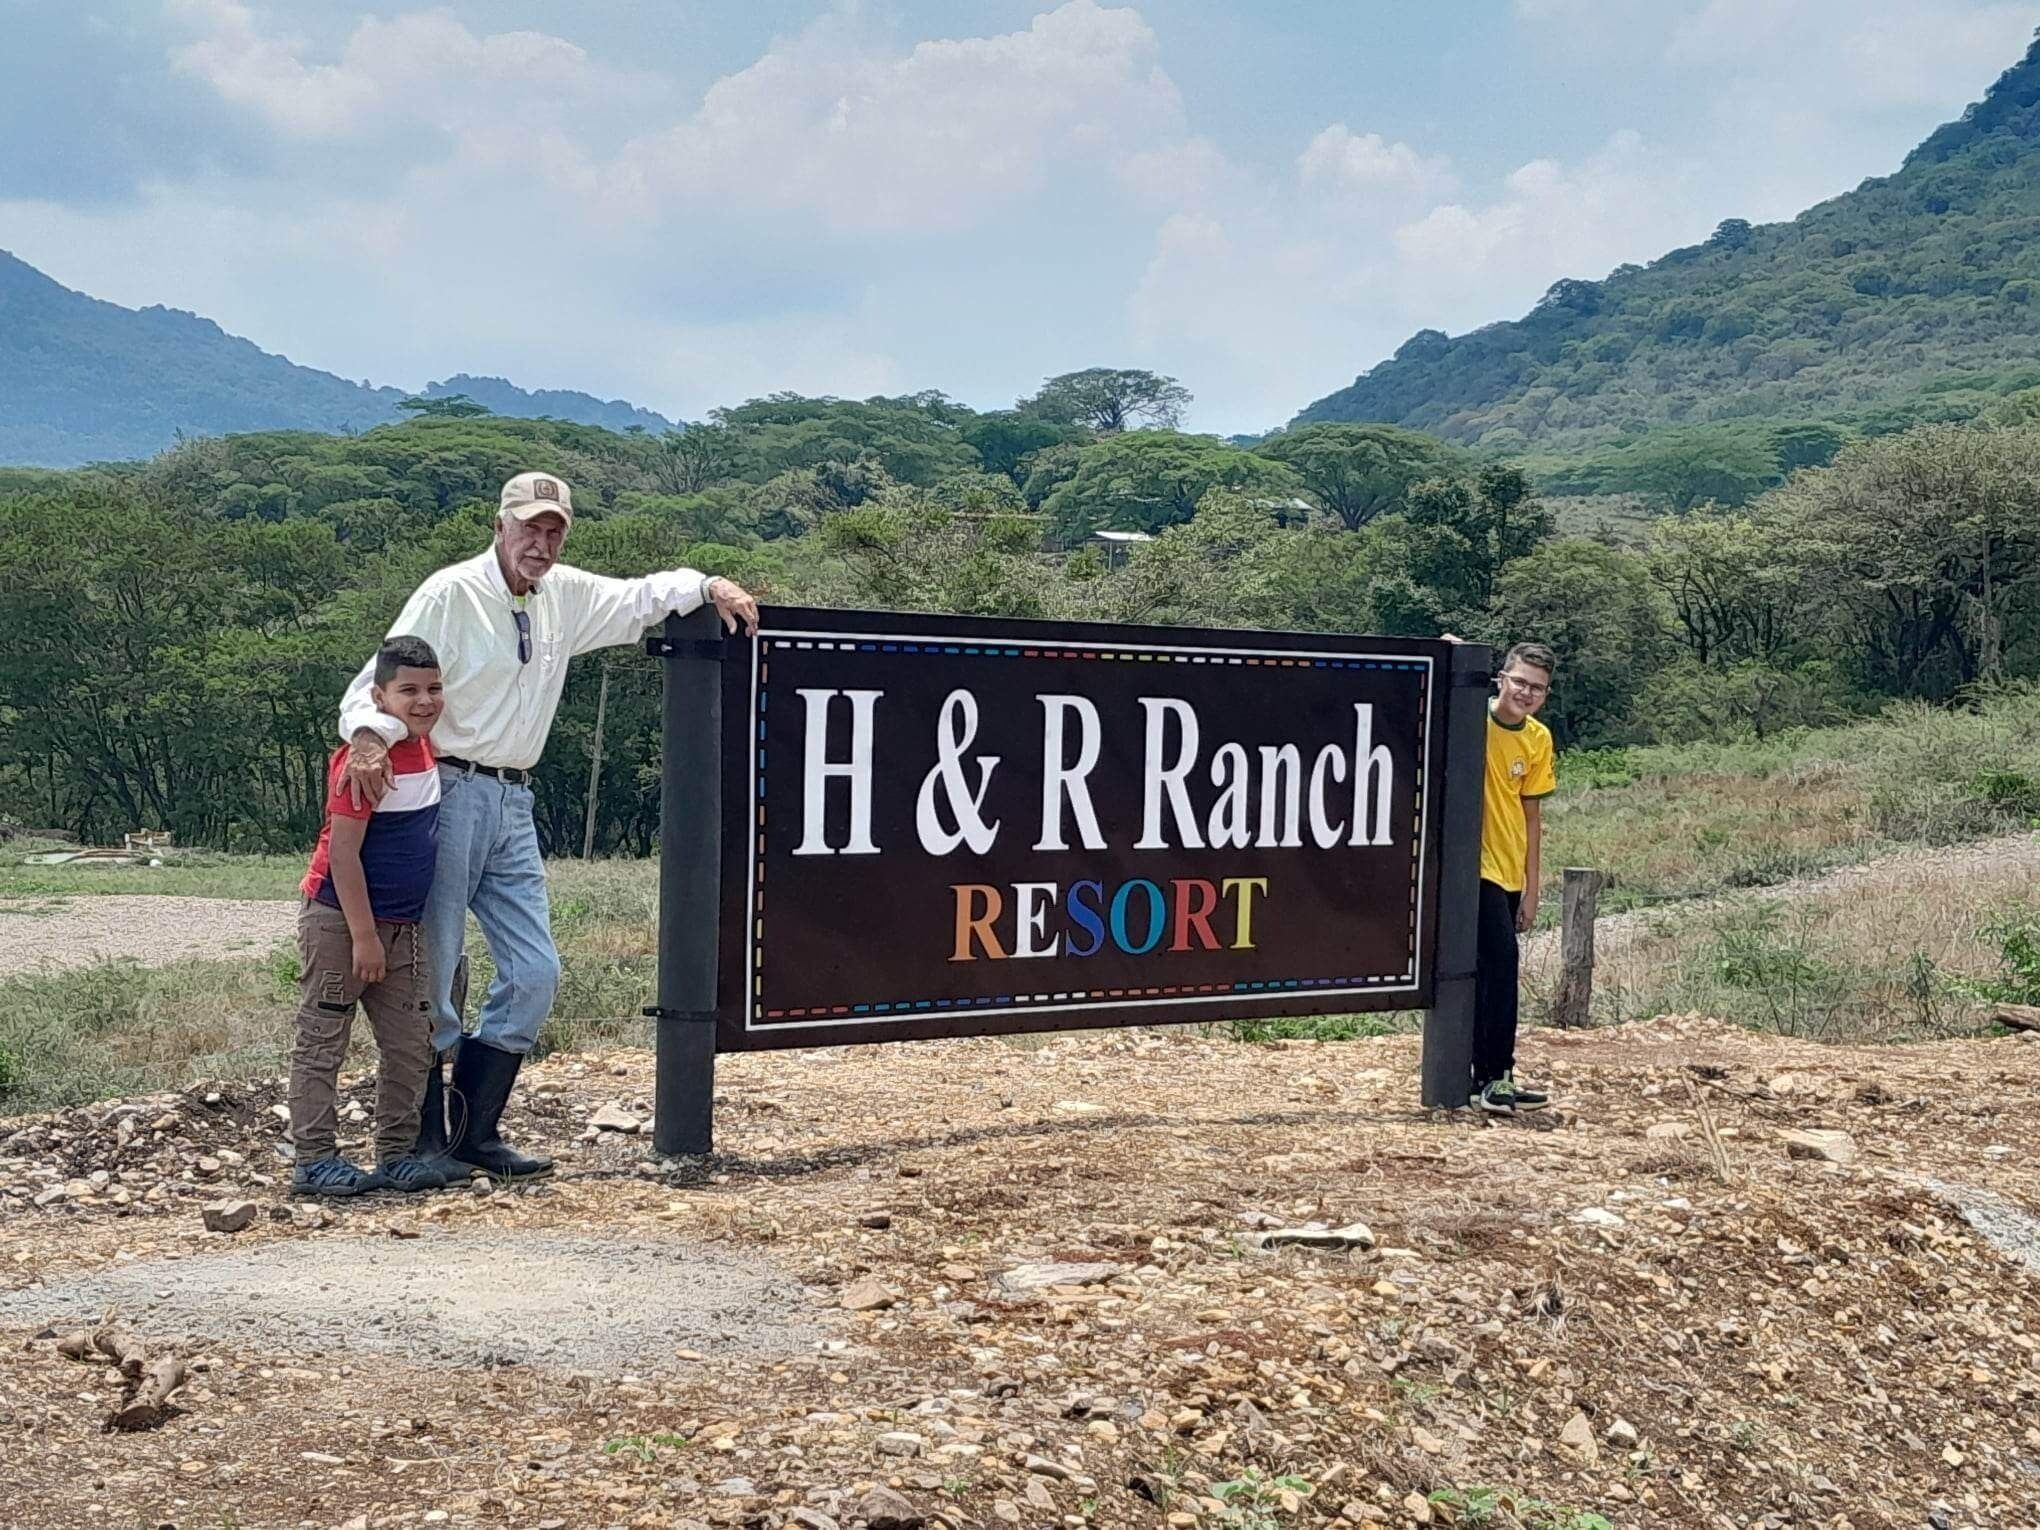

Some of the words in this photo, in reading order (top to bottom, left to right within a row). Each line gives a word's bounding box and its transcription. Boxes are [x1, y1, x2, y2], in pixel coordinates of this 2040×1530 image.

[792, 688, 884, 856] H
[916, 688, 1001, 857] &
[1031, 694, 1108, 851] R
[1133, 697, 1394, 850] Ranch
[948, 877, 1269, 962] RESORT
